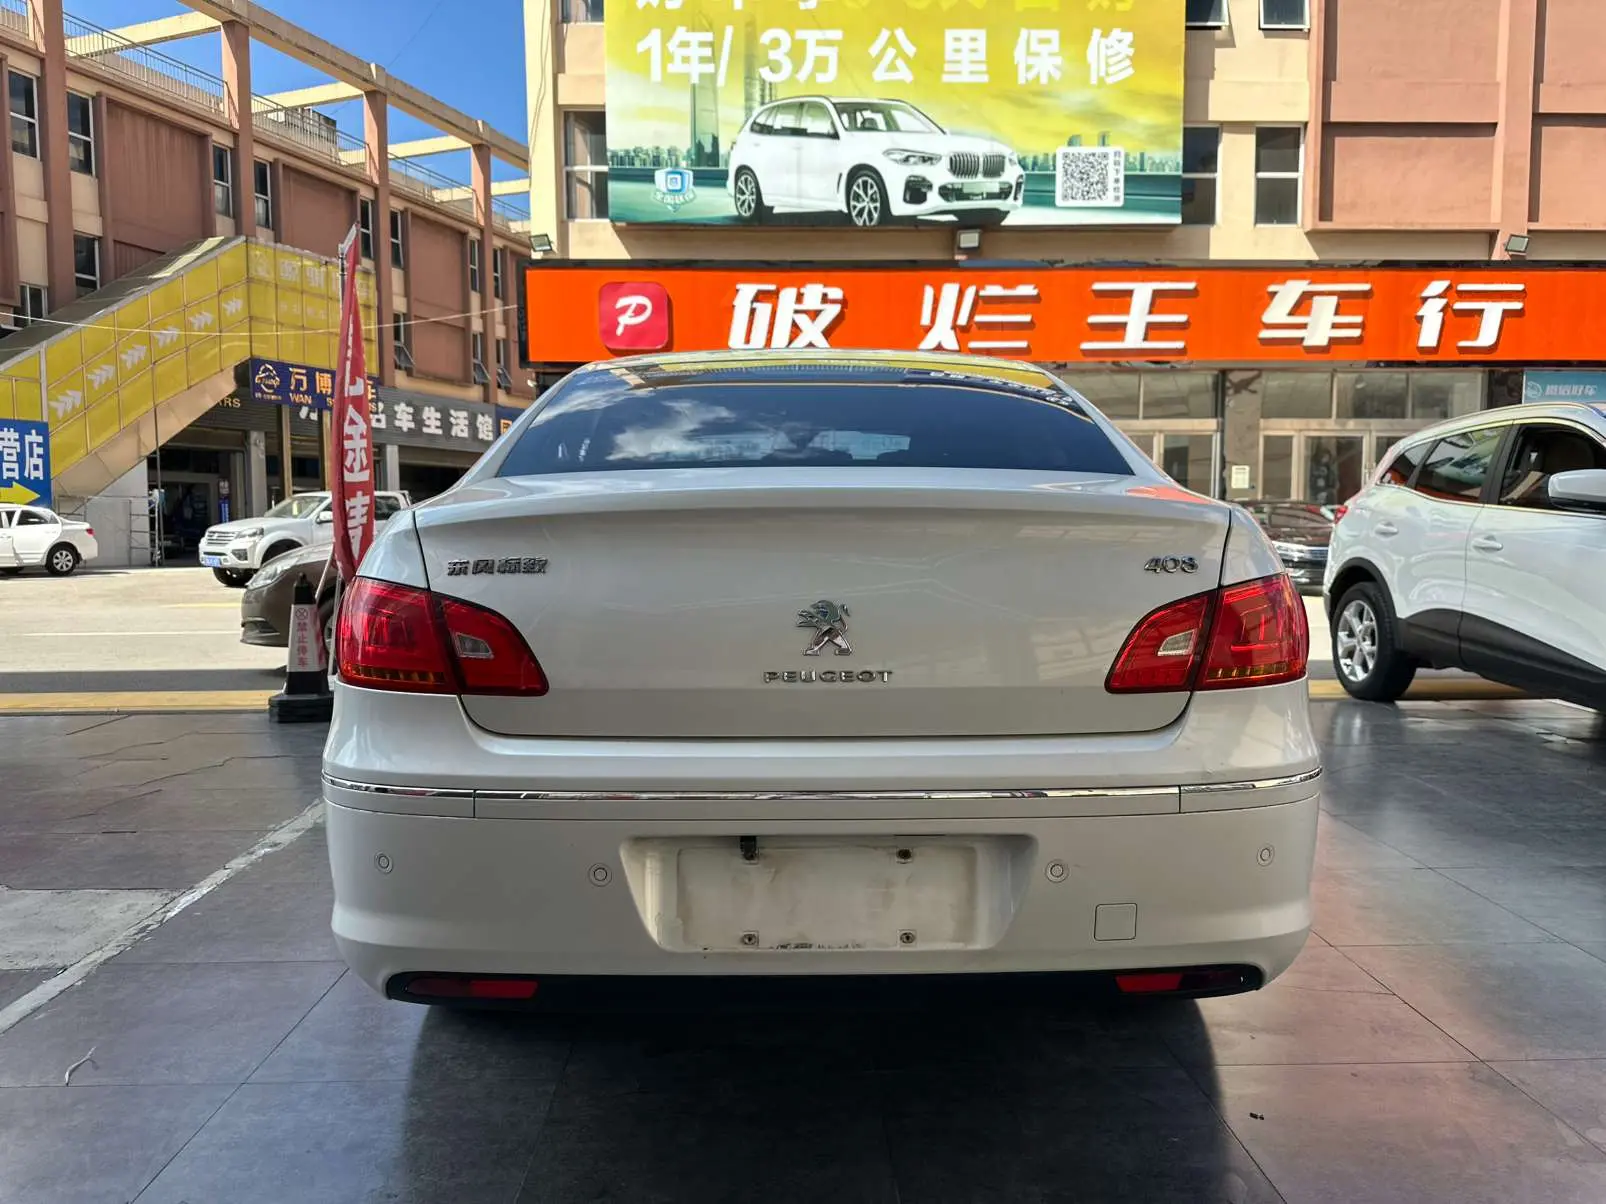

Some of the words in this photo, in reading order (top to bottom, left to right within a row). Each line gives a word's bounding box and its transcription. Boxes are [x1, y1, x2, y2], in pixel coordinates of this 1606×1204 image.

[728, 280, 1526, 350] 破烂王车行
[447, 557, 548, 576] 东风标致
[1143, 555, 1199, 574] 408
[763, 670, 893, 683] PEUGEOT
